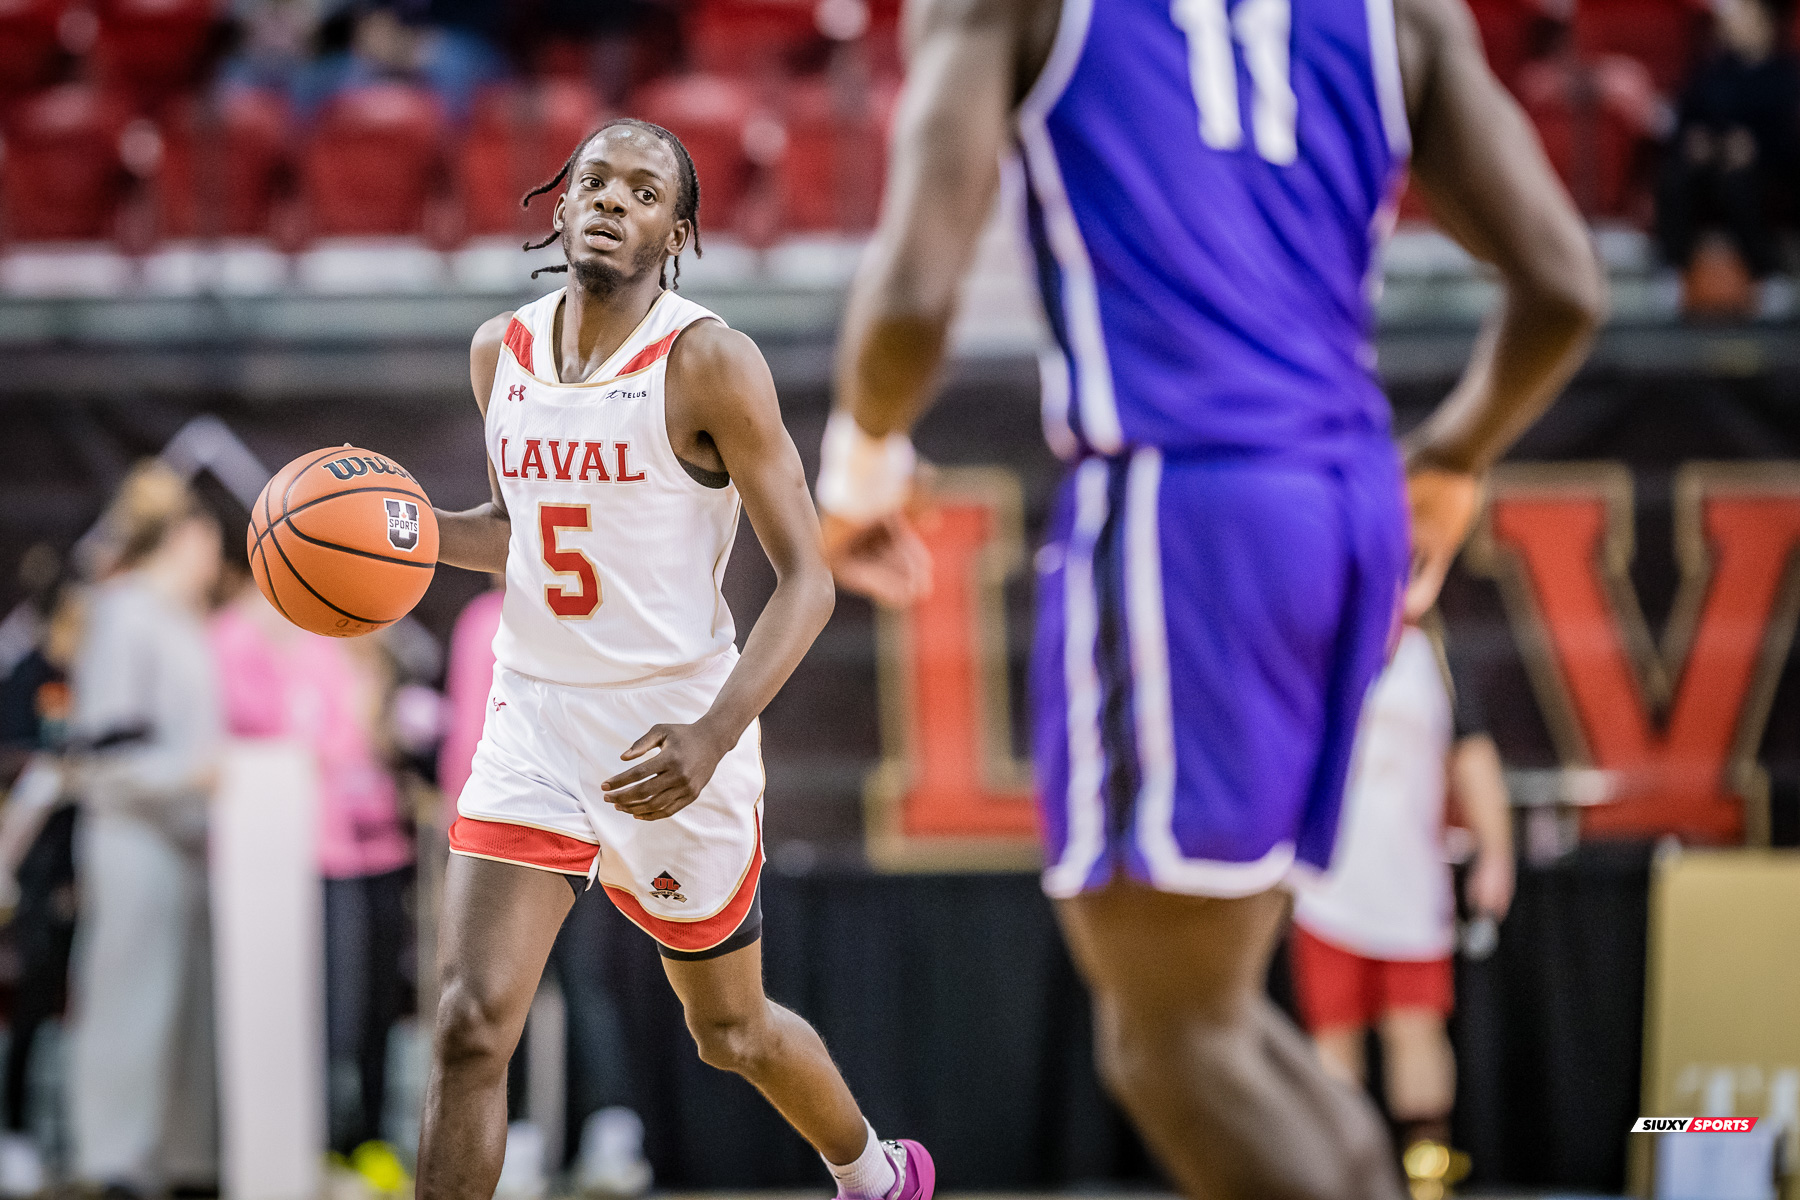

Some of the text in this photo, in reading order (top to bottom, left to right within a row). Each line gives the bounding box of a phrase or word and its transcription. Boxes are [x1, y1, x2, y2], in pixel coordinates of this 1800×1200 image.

[1169, 0, 1298, 166] 11
[500, 436, 648, 484] LAVAL
[389, 518, 418, 532] SPORTS
[538, 502, 603, 620] 5
[653, 877, 680, 891] UL
